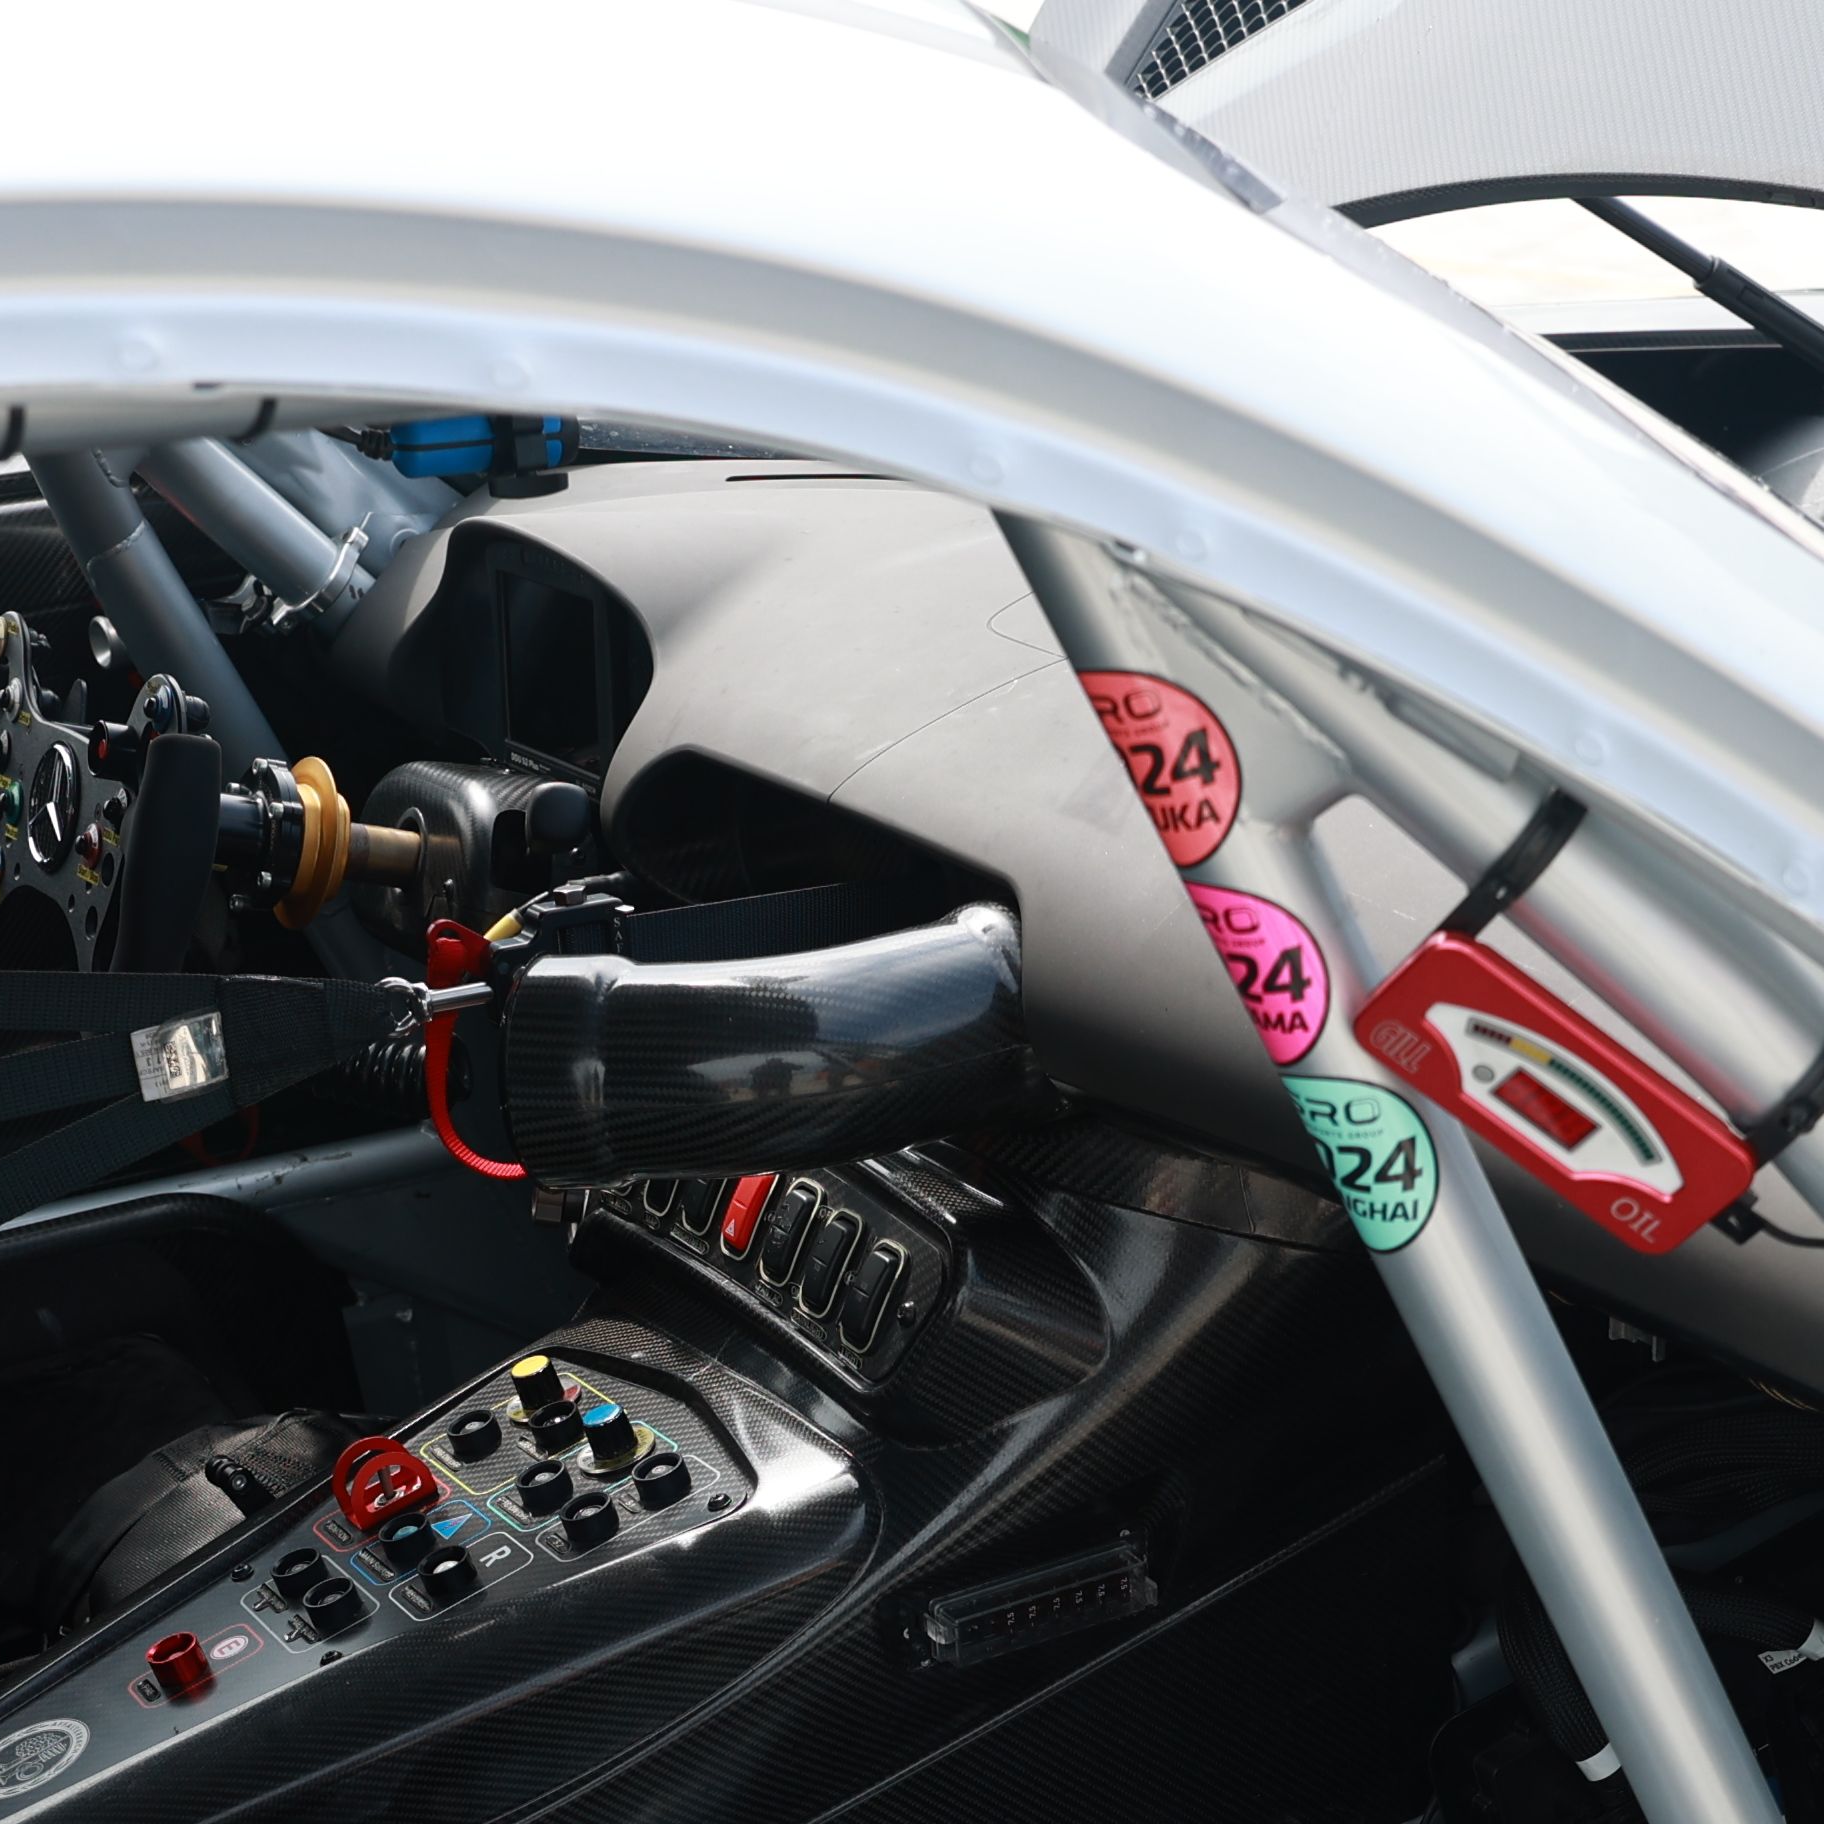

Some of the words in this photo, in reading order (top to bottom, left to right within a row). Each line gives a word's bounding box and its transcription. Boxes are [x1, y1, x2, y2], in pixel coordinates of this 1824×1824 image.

[1088, 688, 1161, 723] RO
[1127, 728, 1221, 795] 24
[1154, 798, 1220, 832] UKA
[1197, 905, 1258, 934] RO
[1226, 946, 1312, 1003] 24
[1250, 1011, 1309, 1035] AMA
[1370, 1018, 1432, 1074] GILL
[1324, 1135, 1423, 1193] 024
[1345, 1195, 1419, 1222] GHAI
[1610, 1196, 1664, 1245] OIL
[479, 1545, 512, 1568] R
[217, 1639, 243, 1656] E
